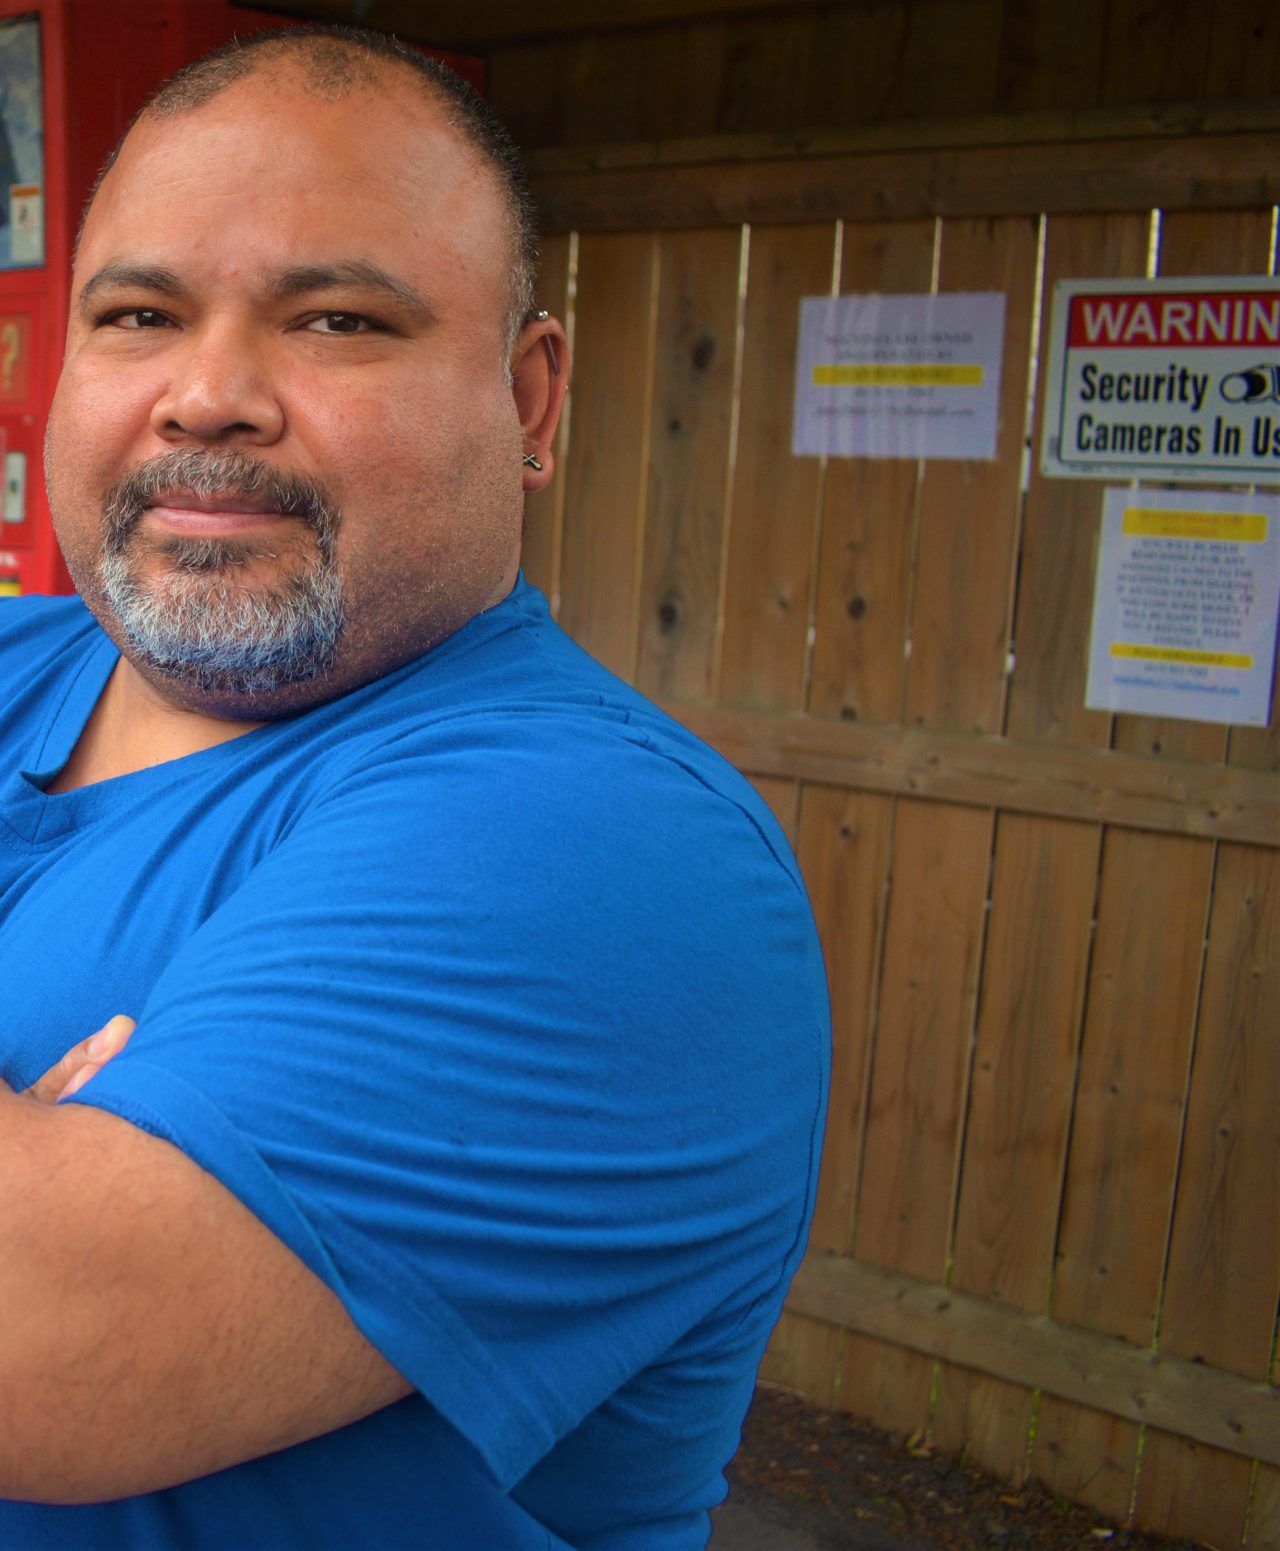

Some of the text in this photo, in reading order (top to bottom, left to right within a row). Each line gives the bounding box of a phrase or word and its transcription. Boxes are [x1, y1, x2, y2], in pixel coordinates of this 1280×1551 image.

[1082, 301, 1280, 342] WARNIN
[1080, 363, 1208, 411] Security
[1076, 414, 1201, 454] Cameras
[1213, 416, 1241, 456] In
